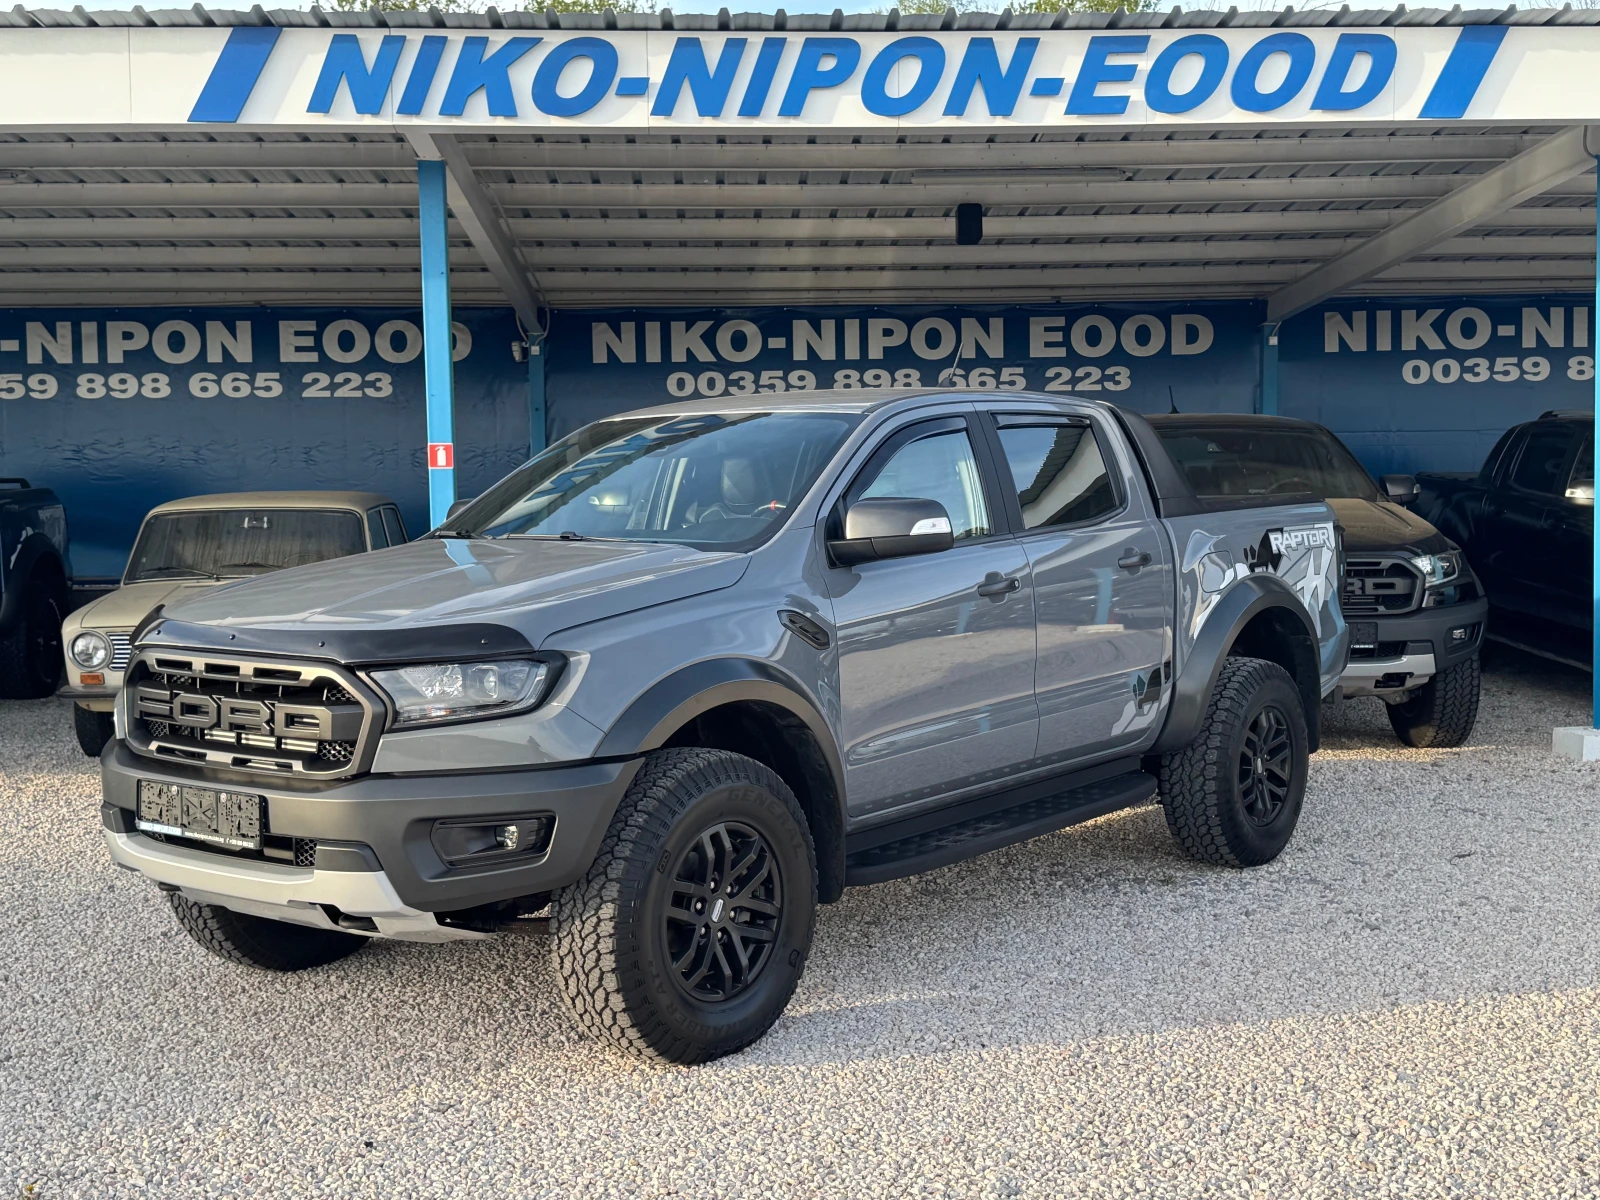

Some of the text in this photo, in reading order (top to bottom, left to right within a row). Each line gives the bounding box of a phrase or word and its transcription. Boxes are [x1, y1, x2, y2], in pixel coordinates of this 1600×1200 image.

[306, 32, 1398, 117] NIKO-NIPON-EOOD
[591, 314, 1215, 363] NIKO-NIPON EOOD
[76, 372, 171, 398] 898
[189, 372, 283, 398] 665
[301, 371, 393, 398] 223
[666, 366, 1132, 397] 00359 898 665 223
[1402, 356, 1551, 385] 00359
[1268, 527, 1335, 560] RAPTOR
[134, 685, 333, 741] FORD
